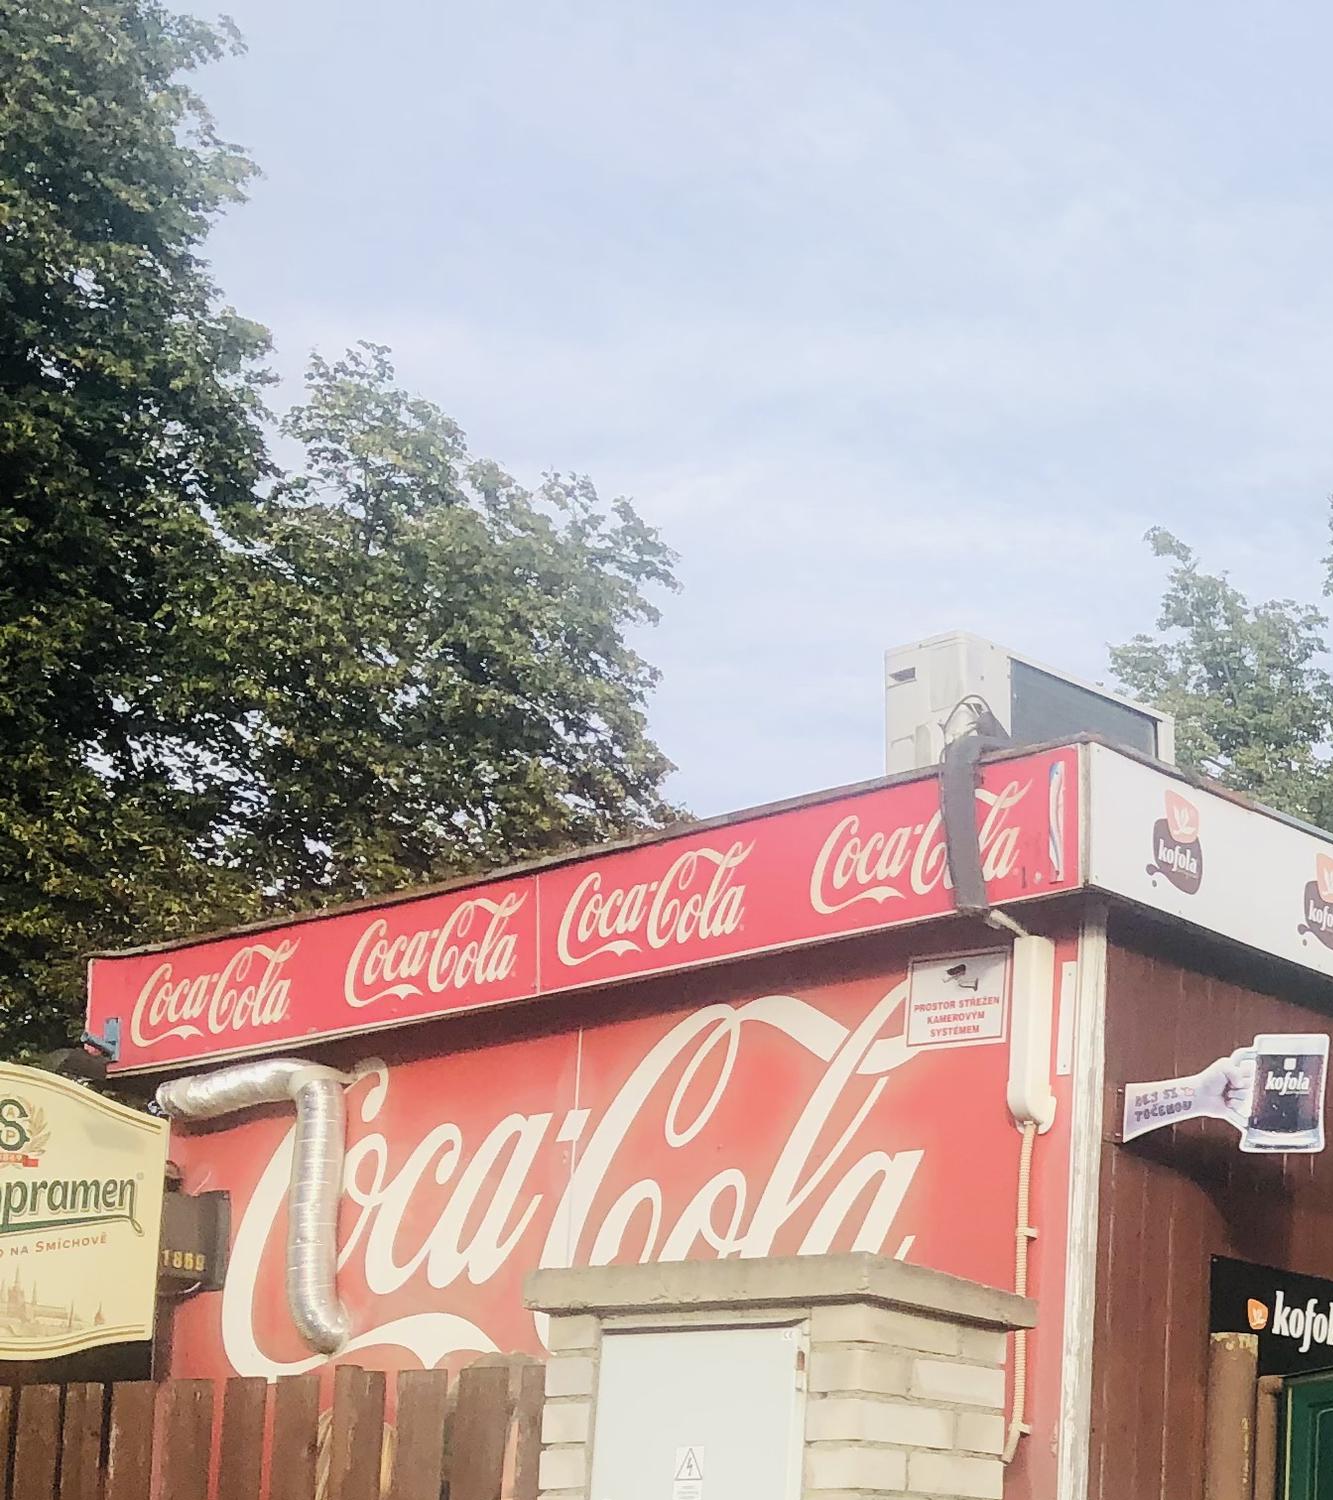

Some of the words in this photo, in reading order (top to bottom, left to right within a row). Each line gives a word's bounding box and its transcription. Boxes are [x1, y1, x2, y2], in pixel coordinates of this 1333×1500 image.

[810, 779, 1033, 914] Coca-Cla
[1158, 838, 1198, 874] kofola
[344, 891, 529, 1008] Coca-Cola
[557, 839, 756, 966] Coca-Cola
[131, 937, 302, 1048] Coca-Cola
[914, 1000, 955, 1012] PROSTOR
[1265, 1071, 1310, 1096] kofola
[0, 1178, 142, 1233] pramen
[222, 995, 926, 1378] Coca-Cola
